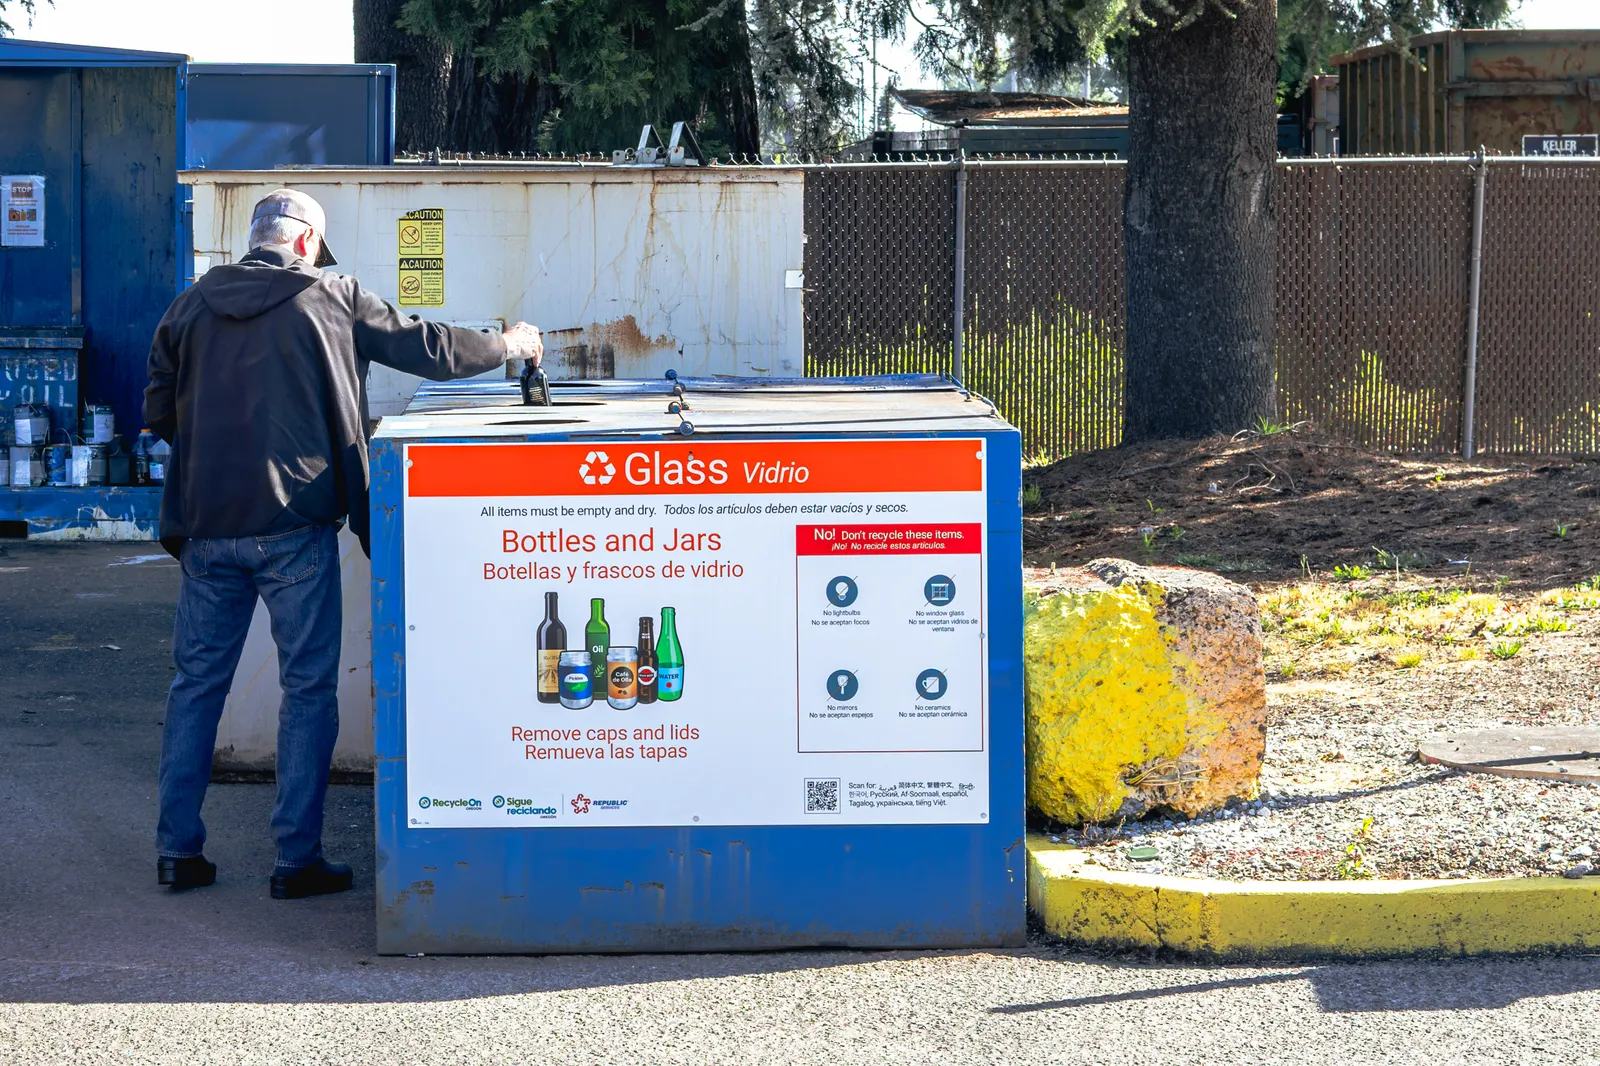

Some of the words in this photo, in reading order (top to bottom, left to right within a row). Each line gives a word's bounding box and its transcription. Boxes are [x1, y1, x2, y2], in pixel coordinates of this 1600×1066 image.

[1542, 140, 1577, 151] KELLER
[408, 210, 442, 220] CAUTION
[408, 260, 442, 269] CAUTION
[20, 384, 74, 408] OIL
[624, 450, 728, 486] Glass
[743, 460, 810, 484] Vidrio
[480, 506, 494, 516] All
[498, 506, 528, 516] items
[530, 507, 558, 516] must
[561, 506, 574, 516] be
[577, 507, 611, 518] empty
[614, 505, 634, 516] and
[637, 505, 657, 518] dry.
[664, 504, 696, 515] Todos
[698, 504, 714, 514] los
[716, 503, 762, 514] artículos
[764, 503, 797, 514] deben
[800, 504, 828, 514] estar
[830, 502, 864, 513] vacíos
[866, 505, 873, 516] y
[875, 504, 908, 513] secos.
[502, 528, 596, 553] Bottles
[605, 528, 654, 552] and
[663, 528, 722, 552] Jars
[814, 528, 836, 540] No!
[842, 530, 866, 540] Don't
[868, 530, 902, 541] recycle
[906, 529, 932, 540] these
[935, 528, 964, 539] items.
[864, 542, 888, 550] recicle
[484, 562, 560, 580] Botellas
[567, 566, 578, 584] y
[583, 561, 656, 579] frascos
[662, 560, 686, 578] de
[691, 560, 744, 578] vidrio
[512, 726, 581, 742] Remove
[586, 728, 628, 744] caps
[633, 724, 664, 740] and
[670, 724, 700, 740] lids
[525, 744, 604, 760] Remueva
[610, 744, 634, 758] las
[640, 744, 688, 762] tapas
[432, 798, 482, 808] RecycleOn
[506, 798, 532, 808] Sigue
[849, 800, 876, 808] Tagalog,
[506, 806, 556, 815] reciclando
